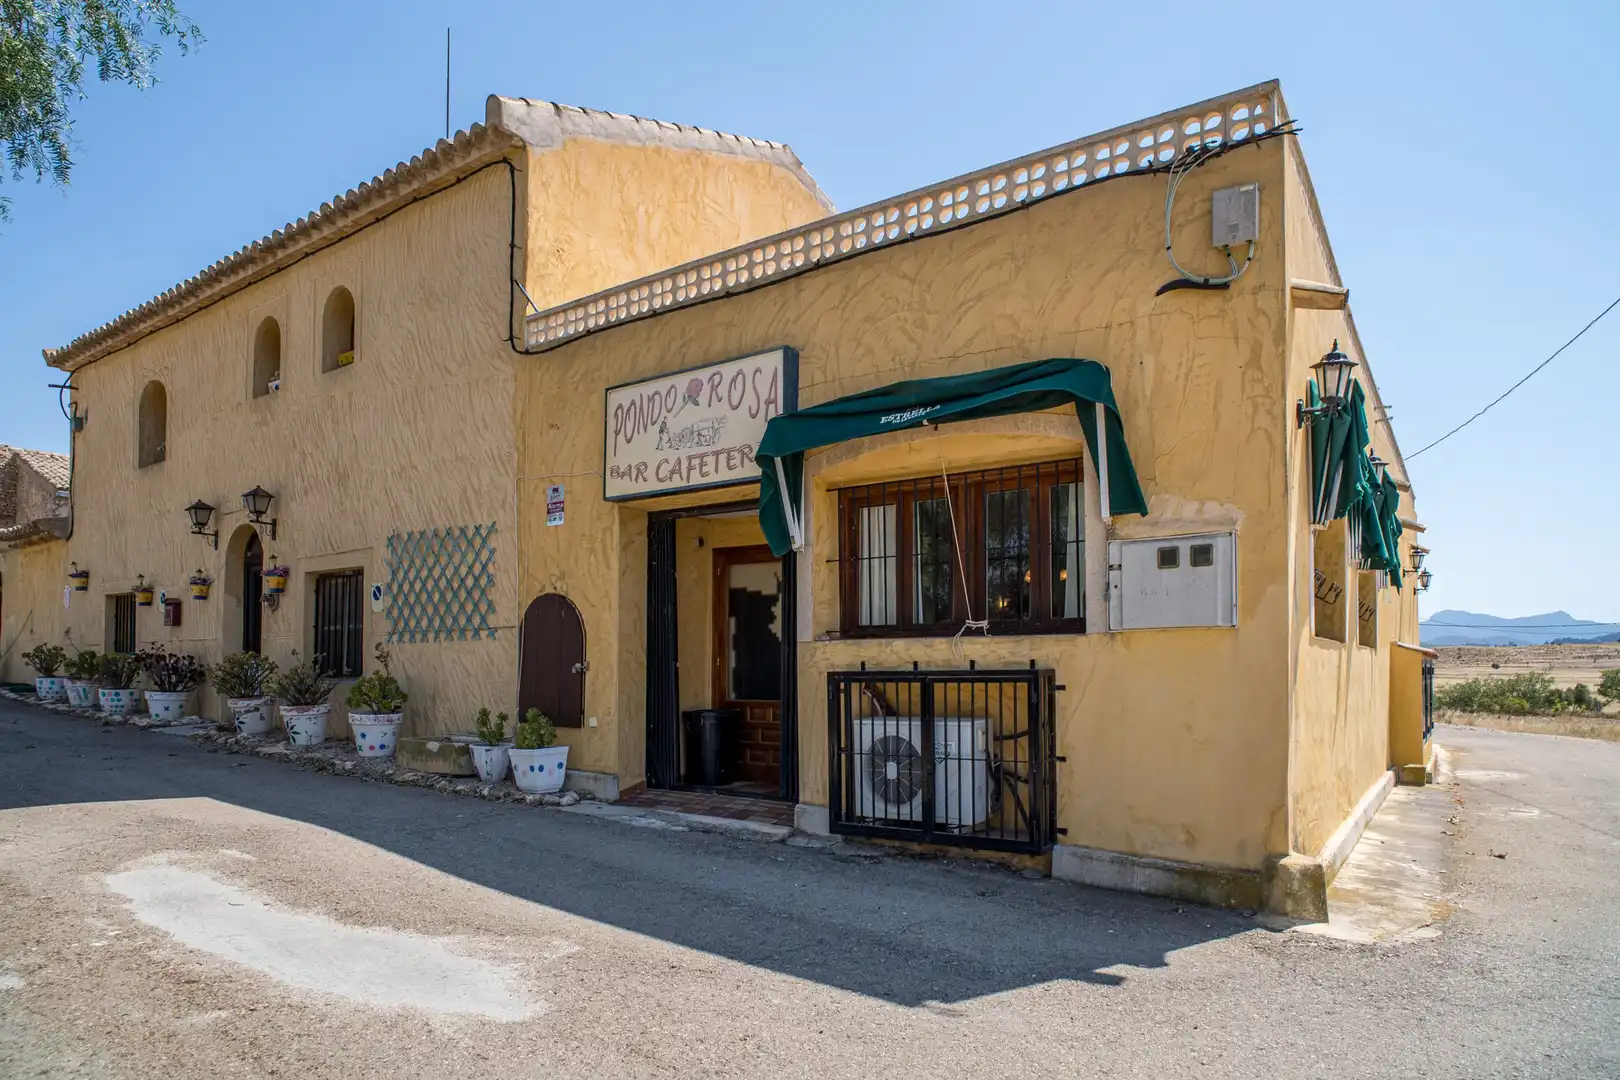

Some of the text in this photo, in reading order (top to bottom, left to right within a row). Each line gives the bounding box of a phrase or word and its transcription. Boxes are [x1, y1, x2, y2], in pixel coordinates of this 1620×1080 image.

[613, 366, 779, 457] PONDO ROSA
[609, 441, 760, 484] BAR CAFETER
